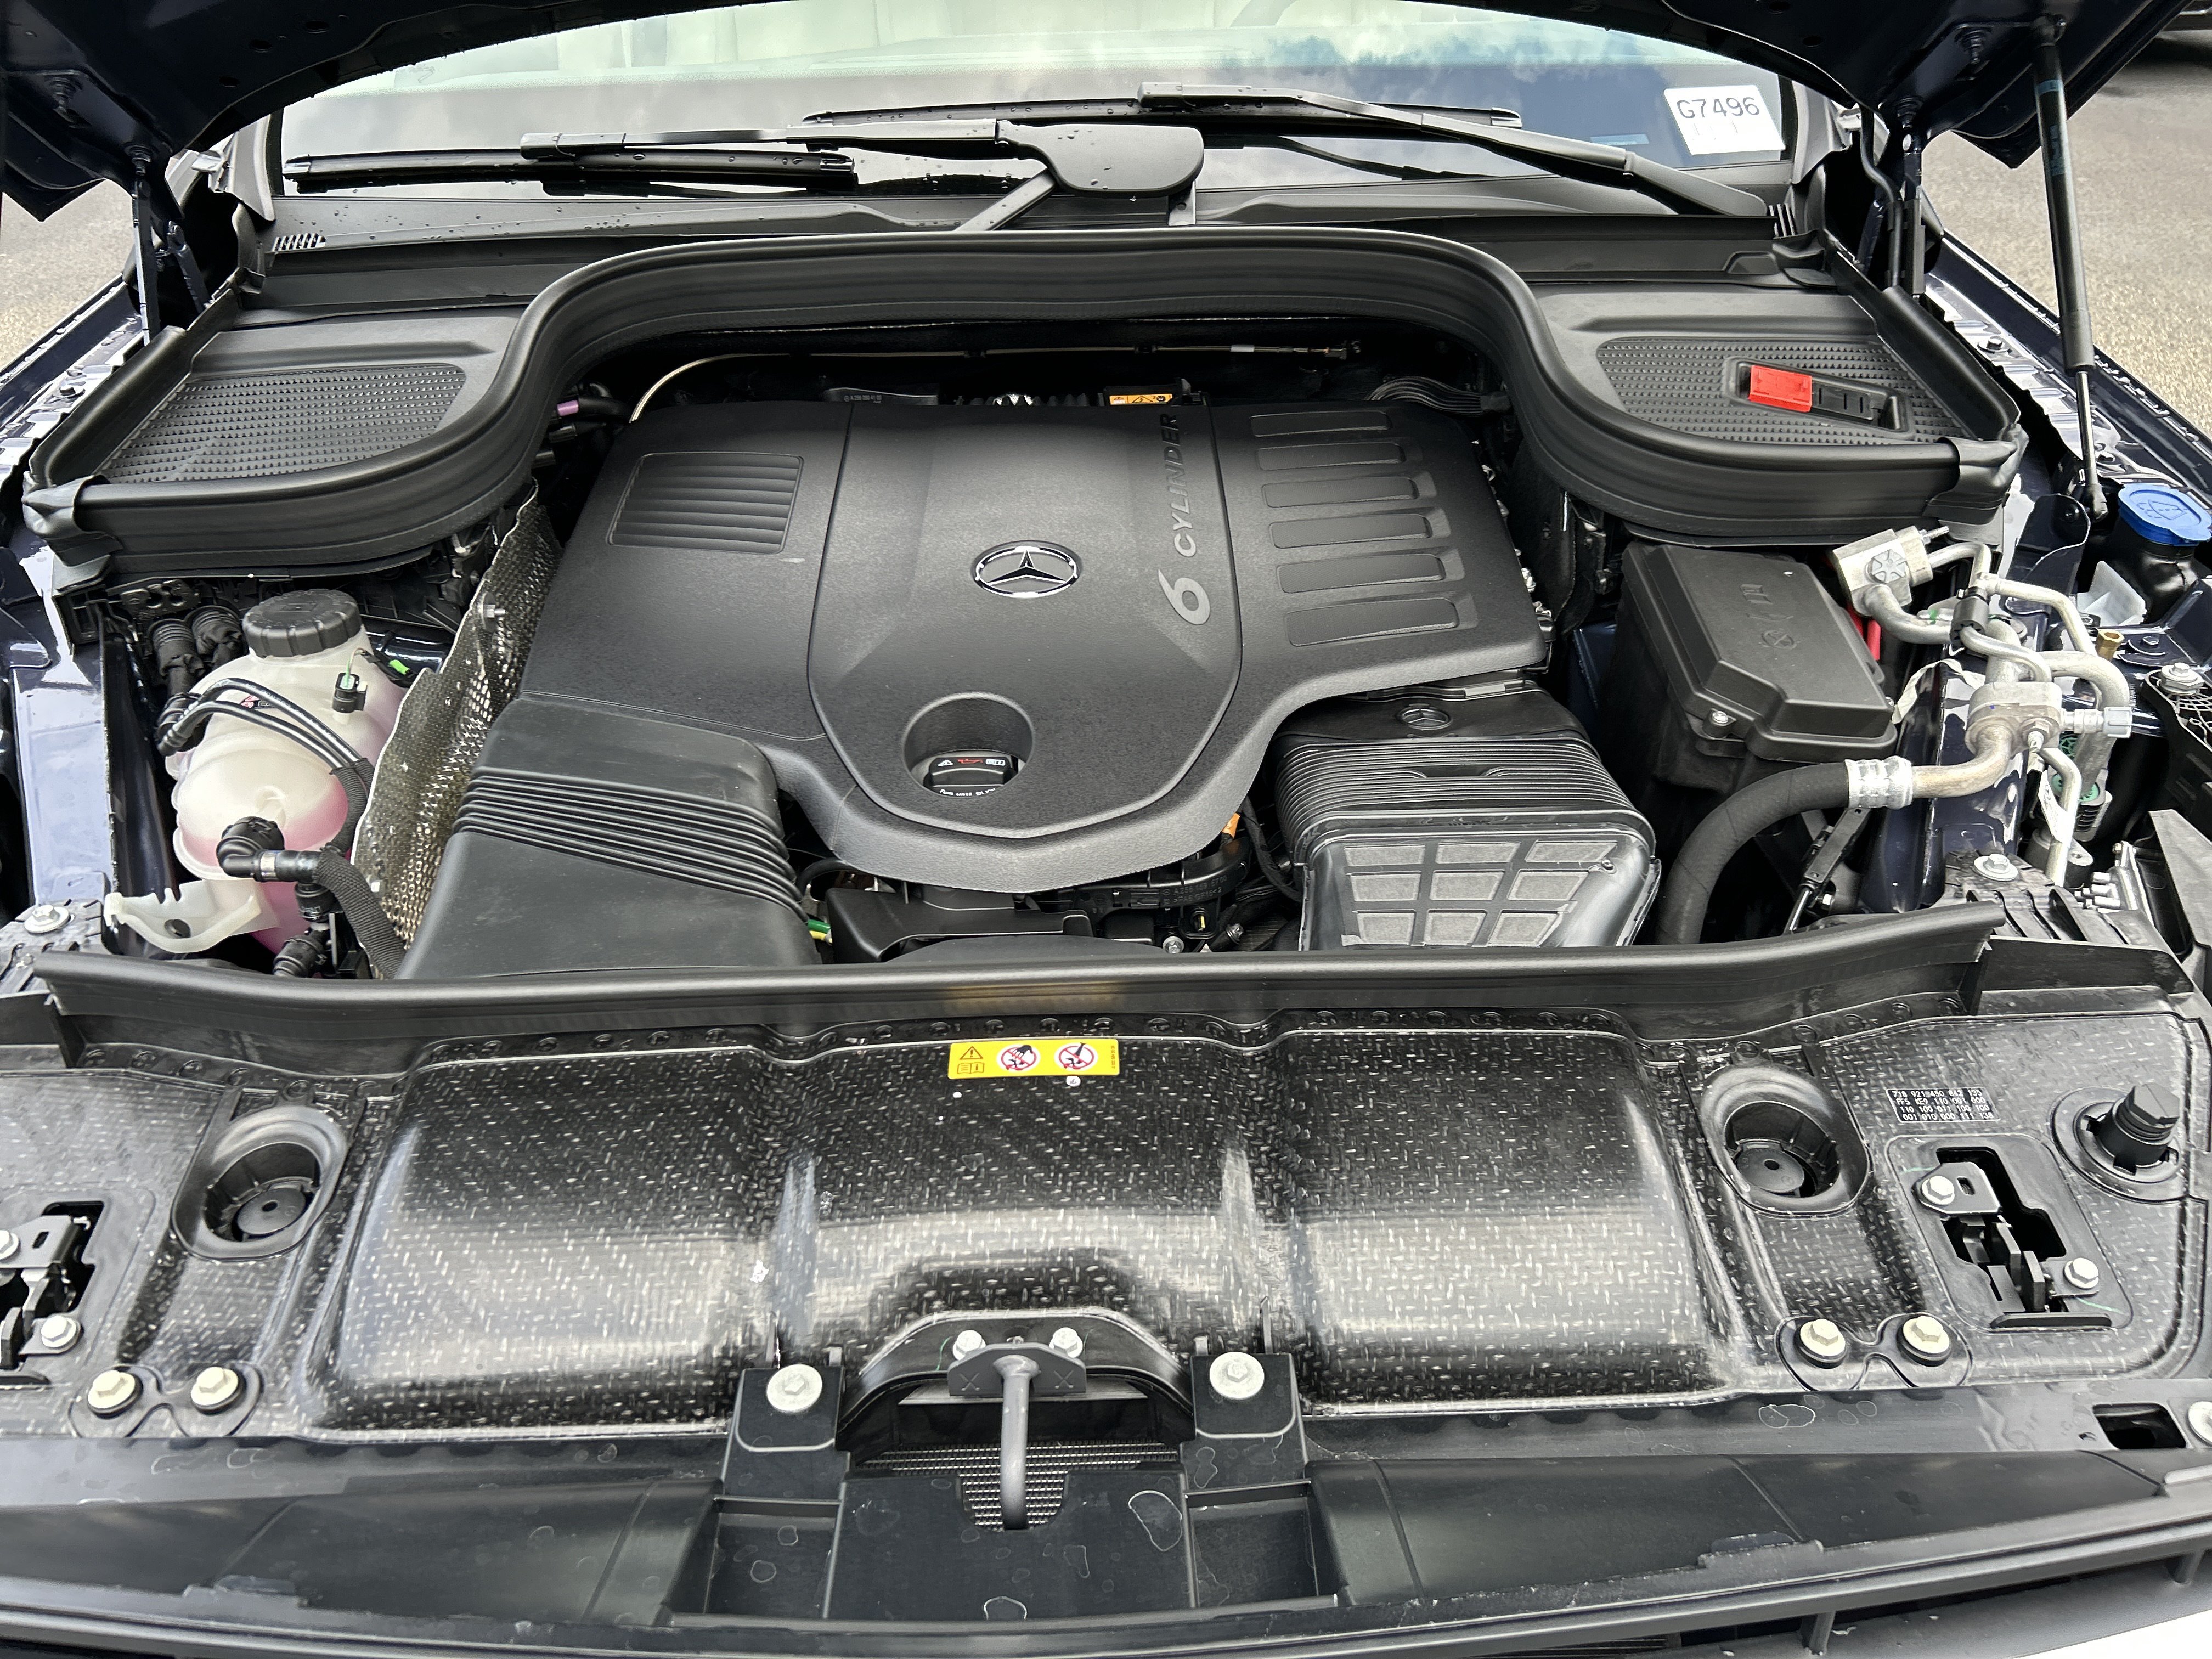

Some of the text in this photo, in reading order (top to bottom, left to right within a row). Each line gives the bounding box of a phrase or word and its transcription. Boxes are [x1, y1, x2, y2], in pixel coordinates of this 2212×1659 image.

[1677, 97, 1760, 119] G7496
[1158, 413, 1211, 626] 6 CYLINDER
